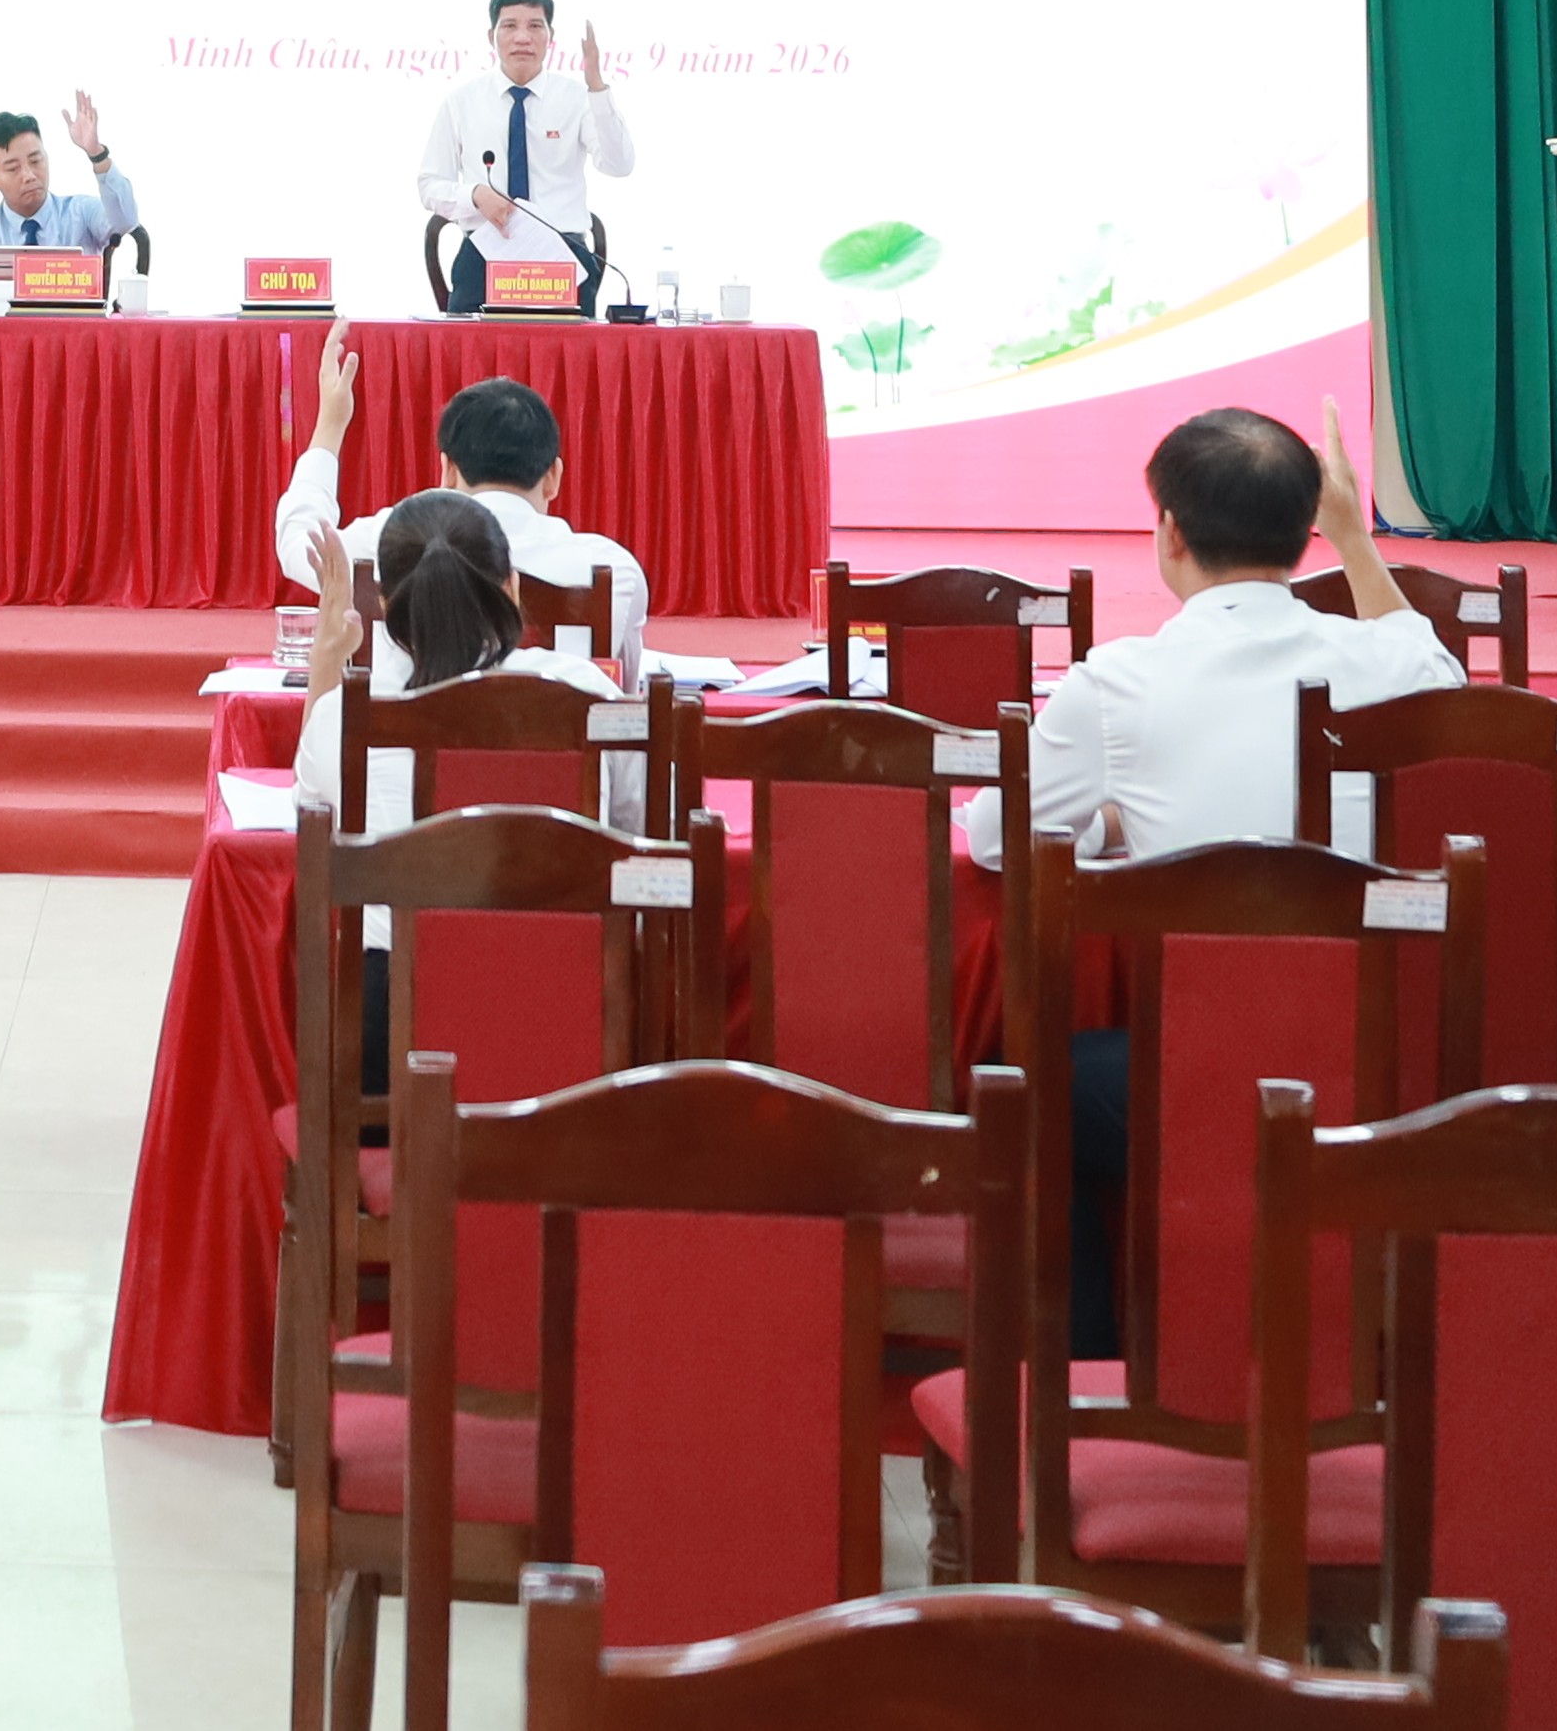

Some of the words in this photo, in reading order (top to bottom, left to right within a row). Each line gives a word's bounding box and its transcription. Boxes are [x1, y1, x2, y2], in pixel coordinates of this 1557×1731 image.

[162, 37, 253, 68] Minh
[269, 38, 370, 72] Châu,
[386, 40, 468, 80] ngày
[649, 43, 666, 70] 9
[679, 44, 753, 73] năm
[769, 43, 849, 74] 2026
[260, 265, 288, 290] CHỦ
[290, 272, 317, 293] TỌA
